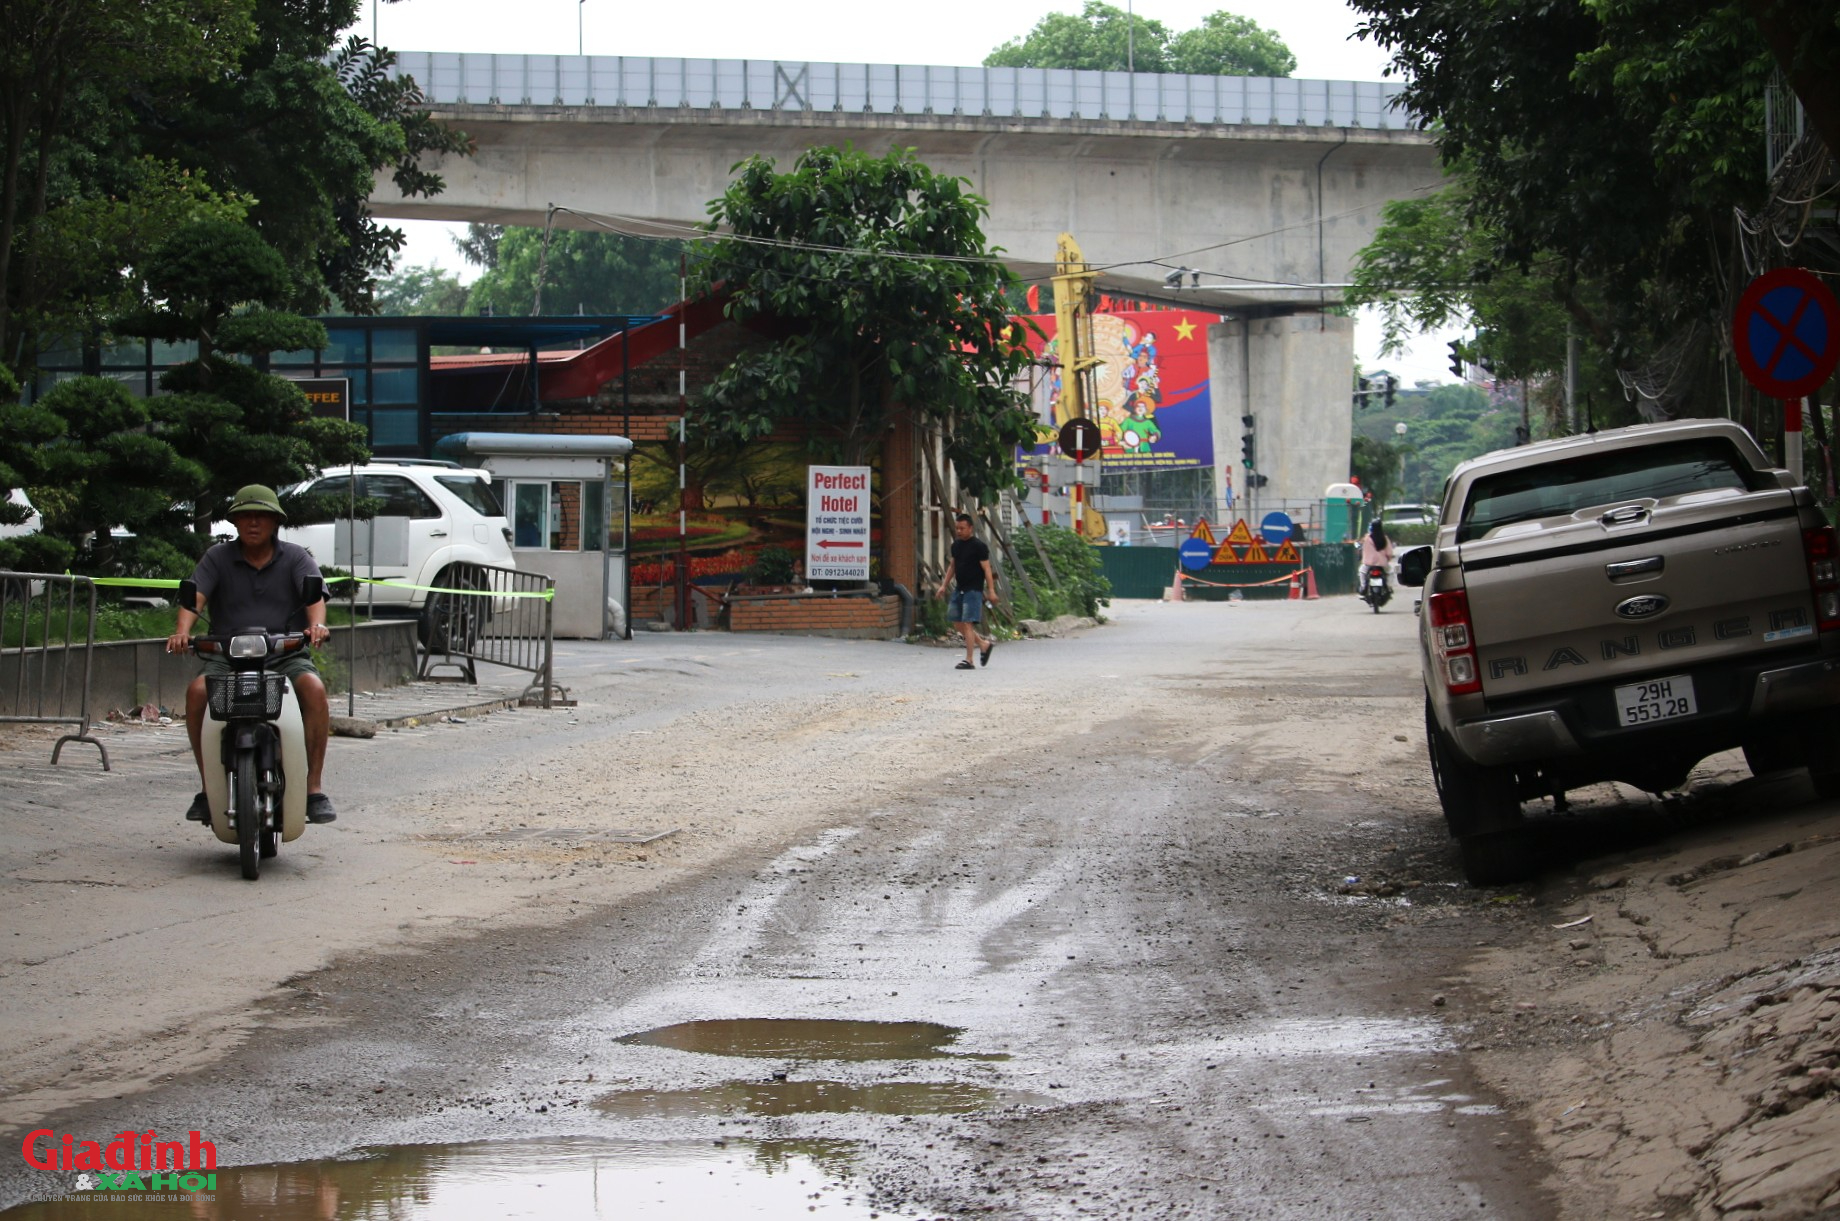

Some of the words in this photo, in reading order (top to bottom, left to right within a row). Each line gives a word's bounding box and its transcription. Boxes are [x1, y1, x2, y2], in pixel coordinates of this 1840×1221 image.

[304, 392, 340, 403] FFEE
[815, 472, 865, 490] Perfect
[821, 495, 858, 512] Hotel
[824, 568, 865, 577] 0912344028
[1627, 598, 1657, 615] Ford
[1488, 606, 1807, 680] RANGER
[1636, 680, 1672, 702] 29H
[1625, 697, 1689, 723] 553.28
